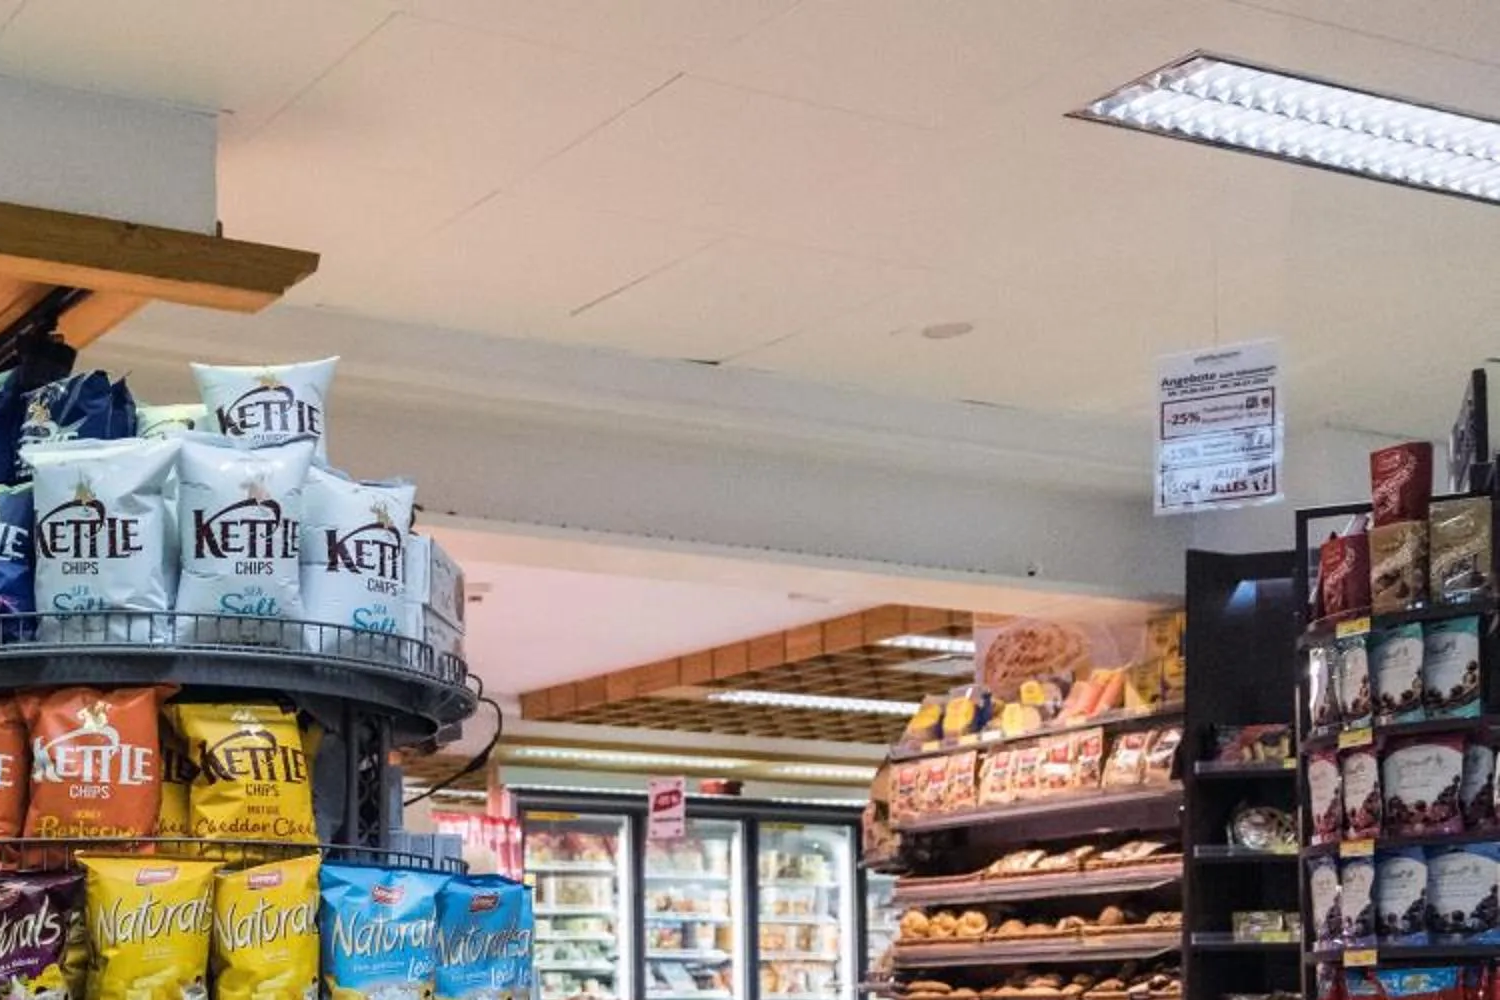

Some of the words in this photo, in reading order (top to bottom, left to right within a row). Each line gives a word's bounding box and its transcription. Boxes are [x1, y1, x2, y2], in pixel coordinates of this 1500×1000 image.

[216, 386, 323, 436] KETTLE
[34, 499, 143, 560] KETTLE
[192, 498, 301, 560] KETTLE
[325, 521, 406, 584] KETT
[61, 561, 100, 576] CHIPS
[235, 561, 274, 576] CHIPS
[218, 592, 282, 617] Salt
[32, 727, 155, 786] KETTLE
[198, 730, 309, 785] KETTLE
[69, 785, 111, 800] CHIPS
[245, 783, 281, 798] CHIPS
[273, 817, 315, 837] Chee
[214, 892, 321, 952] Natural
[332, 906, 437, 958] Natural
